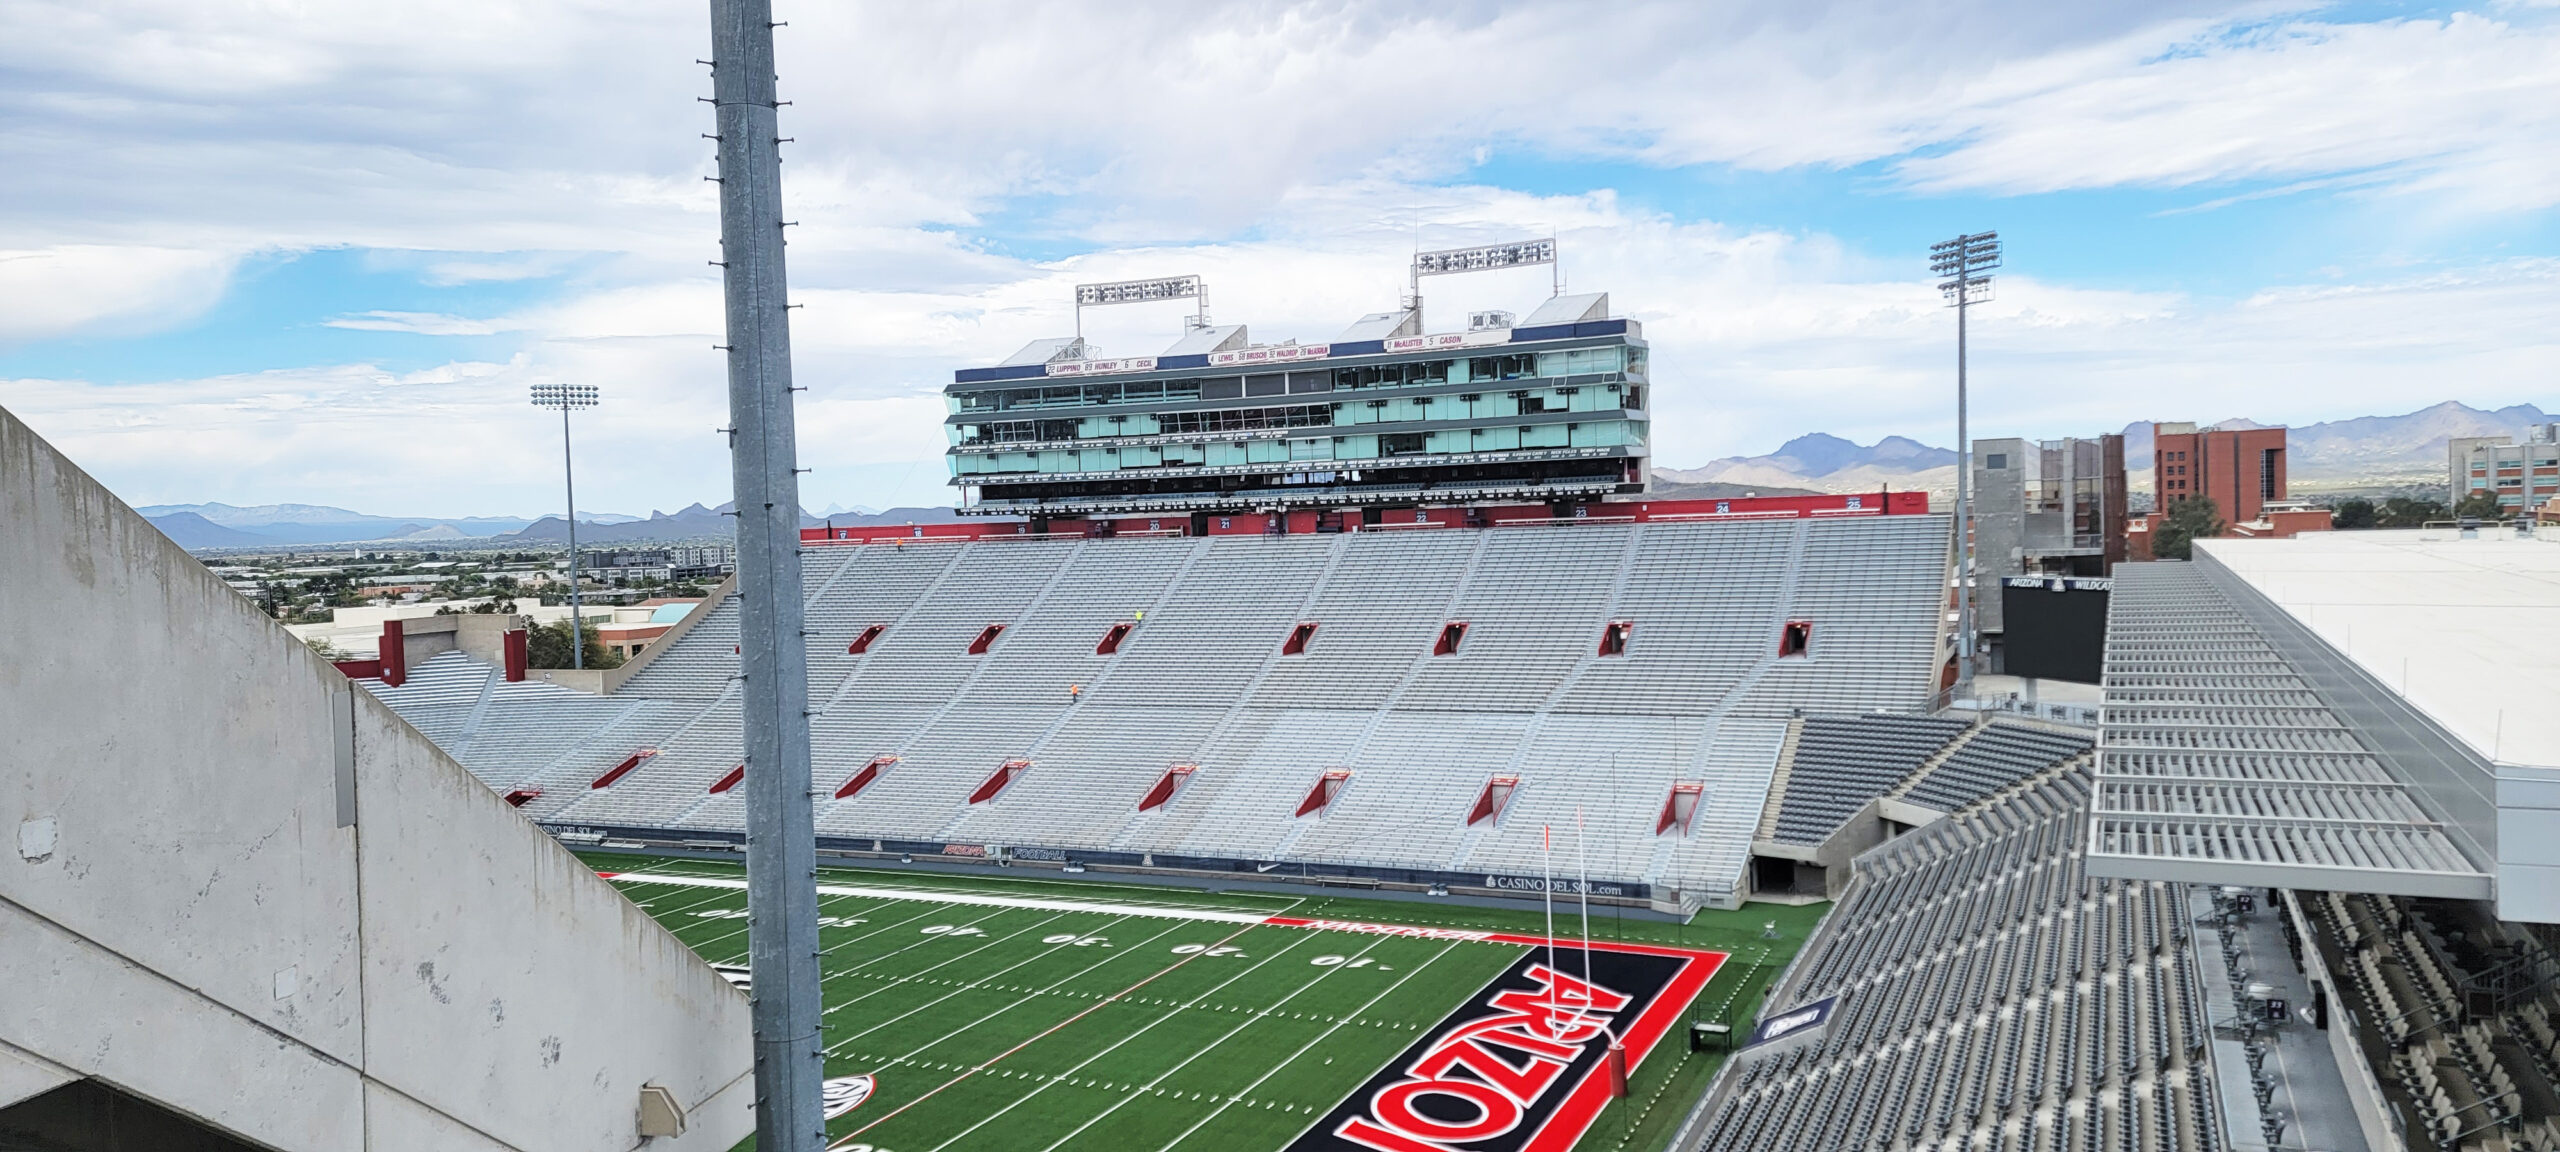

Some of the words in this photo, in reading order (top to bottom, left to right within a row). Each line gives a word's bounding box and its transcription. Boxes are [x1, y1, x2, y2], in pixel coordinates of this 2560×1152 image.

[1394, 339, 1422, 348] McALISTER
[1440, 336, 1462, 344] CASON
[1246, 352, 1267, 360] BRUSCHI
[1276, 350, 1298, 358] WALDROP
[2010, 579, 2044, 587] ARIZONA
[2075, 581, 2113, 590] WILDCAT
[536, 825, 561, 835] ASINO
[942, 845, 984, 856] ARIZONA
[1013, 847, 1066, 860] FOOTBALL
[1498, 877, 1544, 890] CASINO
[1547, 881, 1571, 892] DEL
[1572, 882, 1622, 896] SOL.com
[1042, 934, 1108, 947] 30
[1171, 944, 1245, 957] 20
[1310, 955, 1376, 968] 10
[1334, 962, 1633, 1152] ARIZO
